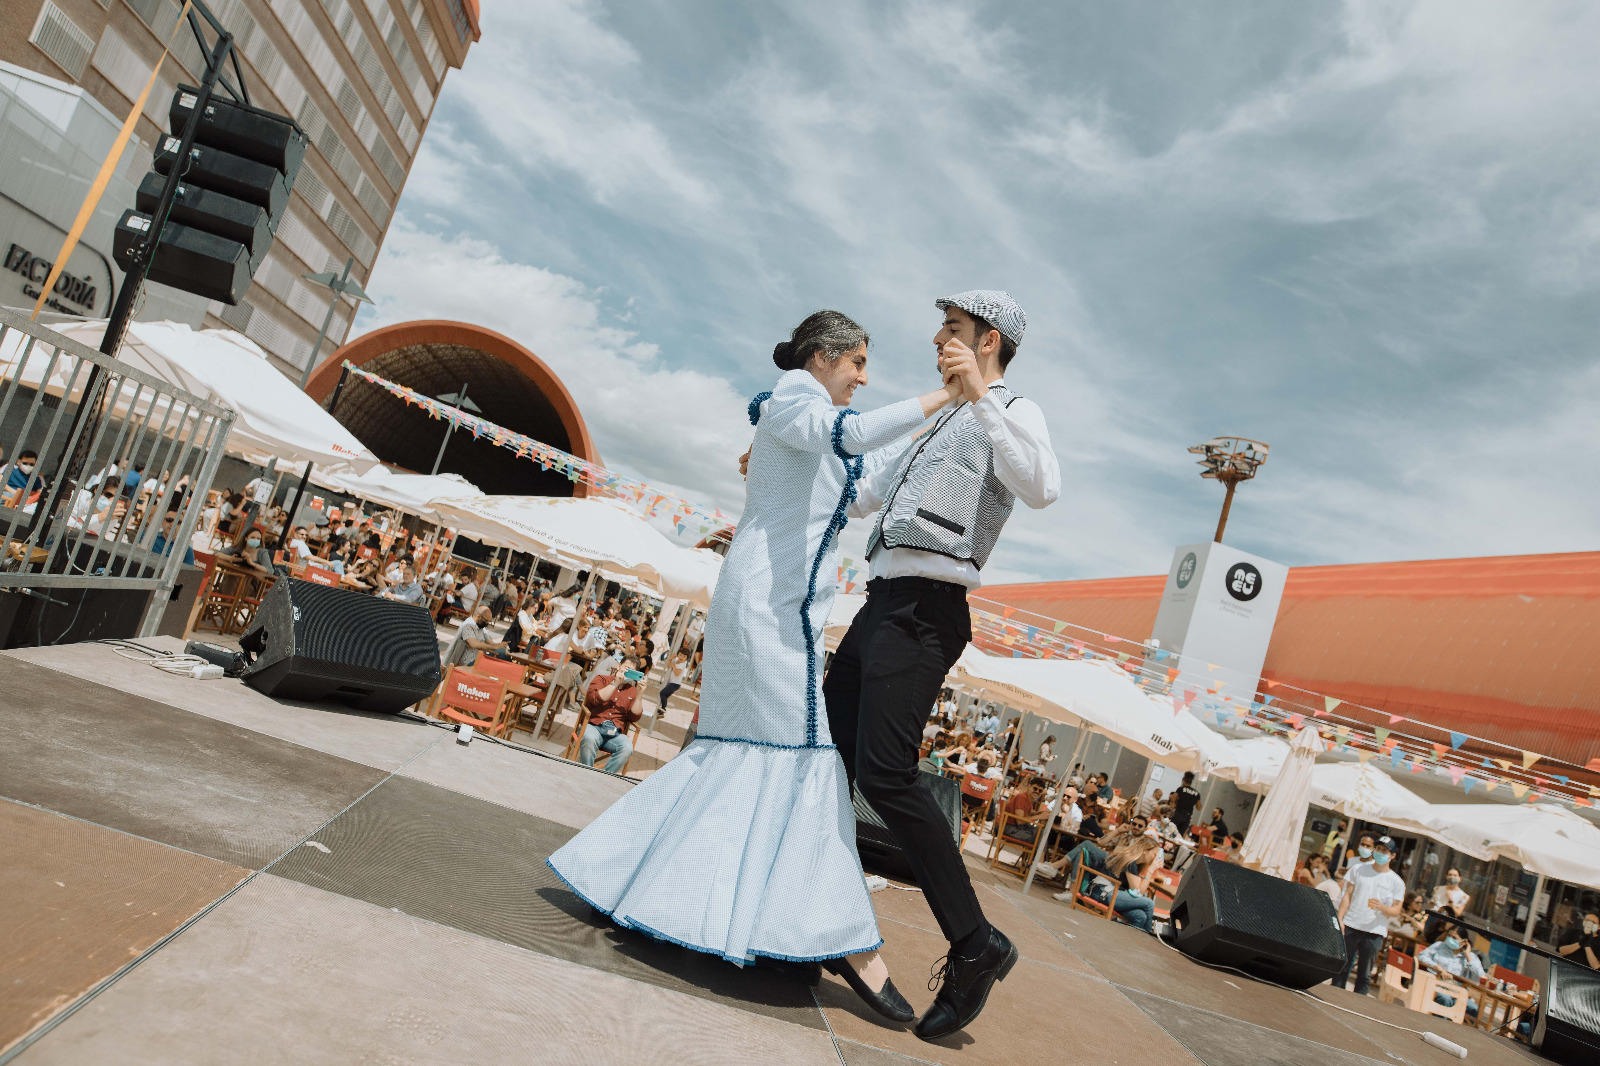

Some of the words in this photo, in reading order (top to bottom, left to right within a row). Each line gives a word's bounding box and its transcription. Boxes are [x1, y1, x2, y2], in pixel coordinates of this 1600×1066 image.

[457, 682, 490, 699] Mahou
[1150, 733, 1173, 751] Mah
[1182, 787, 1198, 797] STAFF
